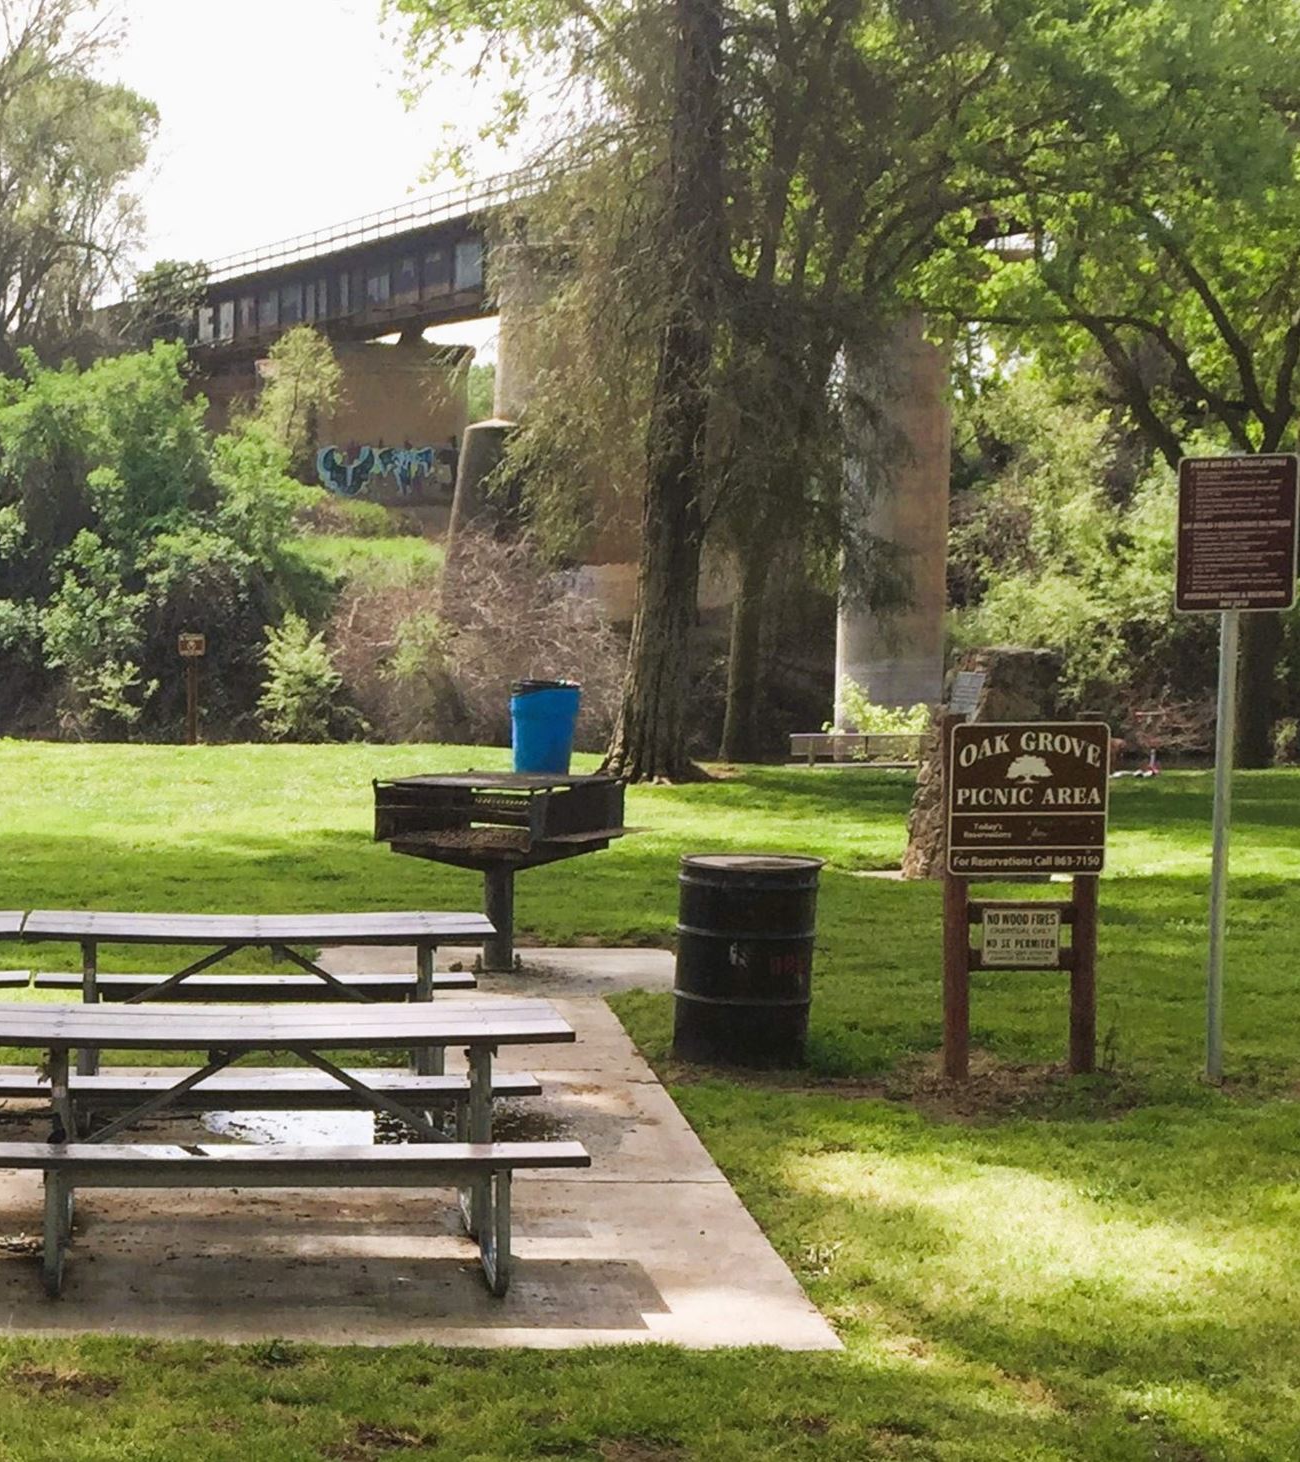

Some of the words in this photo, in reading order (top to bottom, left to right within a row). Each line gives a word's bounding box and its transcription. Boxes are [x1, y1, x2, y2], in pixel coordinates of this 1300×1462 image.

[959, 734, 1011, 767] OAK
[1020, 731, 1101, 767] GROVE
[956, 787, 1034, 805] PICNIC
[1041, 787, 1101, 805] AREA
[953, 856, 970, 866] For
[971, 856, 1032, 867] Reservations
[1034, 856, 1052, 866] Call
[1054, 856, 1100, 866] 863-7150
[987, 913, 1000, 925] NO
[1002, 913, 1029, 925] WOOD
[1031, 913, 1056, 925] FIRES
[986, 939, 998, 948] NO
